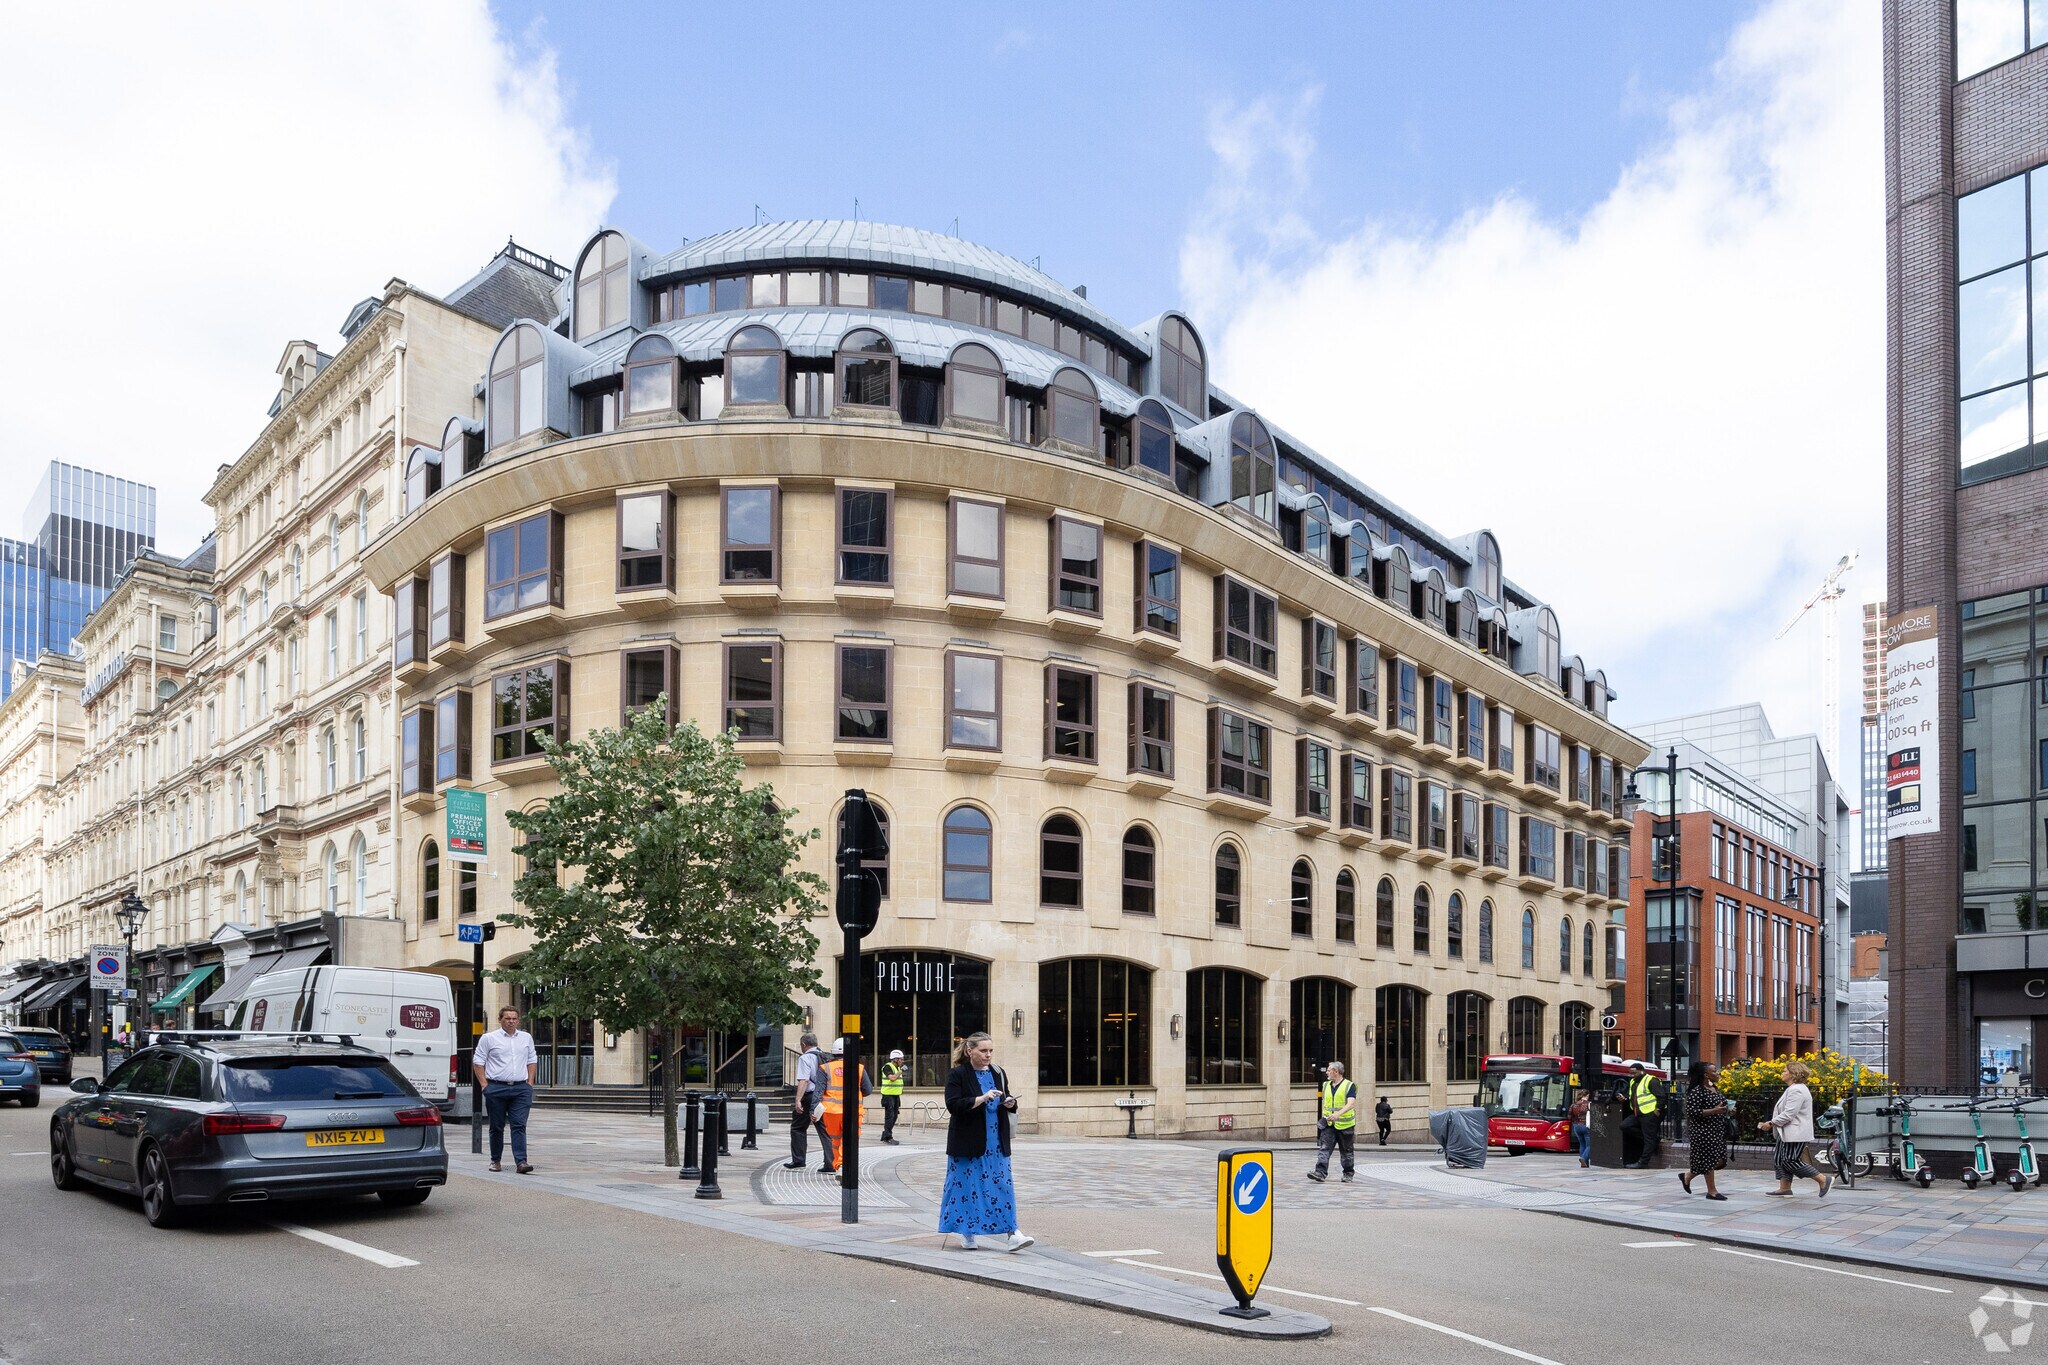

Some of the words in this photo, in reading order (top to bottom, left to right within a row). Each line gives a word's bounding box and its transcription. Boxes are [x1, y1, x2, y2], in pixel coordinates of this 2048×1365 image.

[1887, 615, 1931, 637] OLMORE
[1887, 632, 1902, 646] OW
[1886, 680, 1907, 697] rade
[1908, 676, 1923, 689] A
[1886, 695, 1919, 712] ffices
[1888, 713, 1905, 726] from
[1902, 725, 1917, 737] sq
[1920, 719, 1932, 733] ft
[1900, 751, 1919, 764] JLL
[450, 813, 483, 822] PREMIUM
[452, 819, 482, 827] OFFICES
[877, 961, 956, 993] PASTURE
[2023, 978, 2046, 999] C
[409, 1010, 434, 1018] WINES
[314, 1132, 346, 1144] NX15
[350, 1129, 376, 1142] ZVJ
